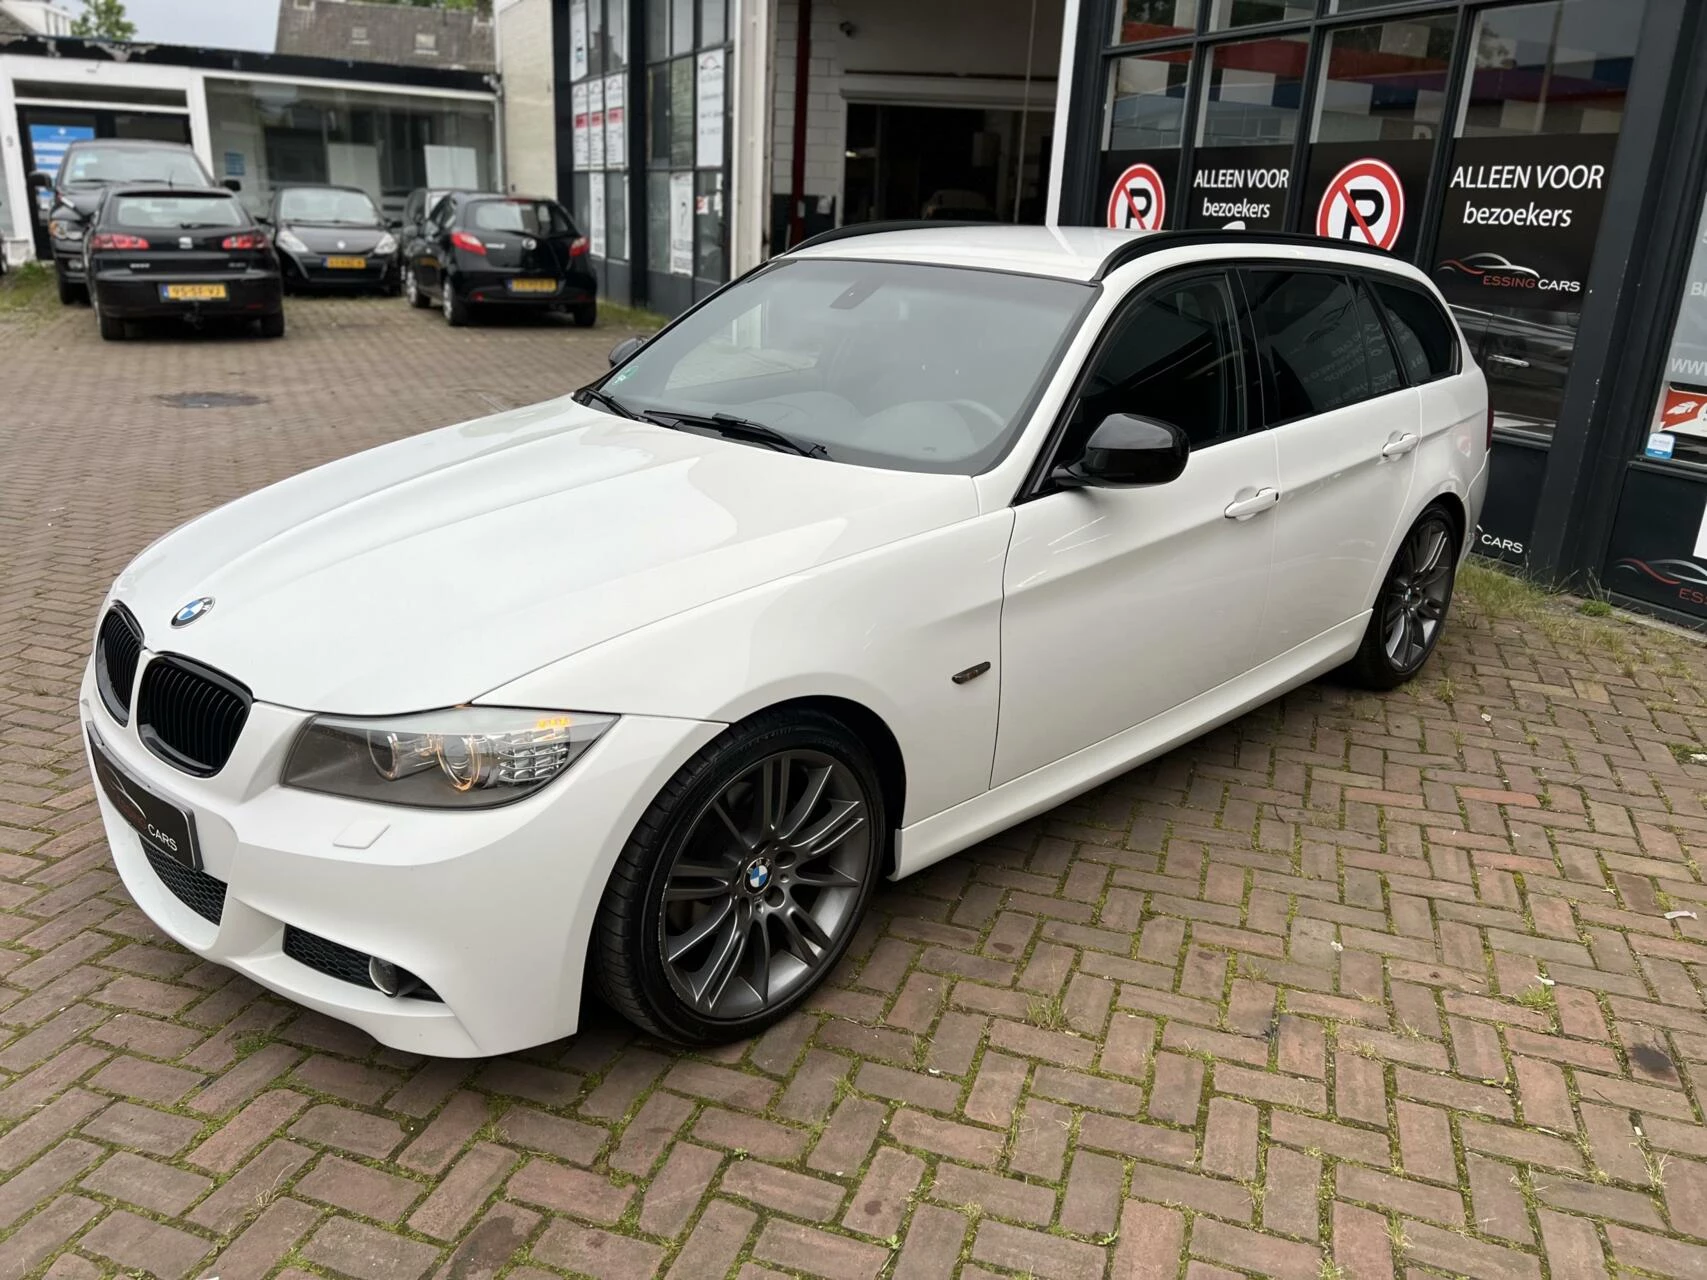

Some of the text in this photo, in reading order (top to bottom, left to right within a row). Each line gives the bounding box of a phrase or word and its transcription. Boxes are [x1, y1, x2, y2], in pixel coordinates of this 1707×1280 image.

[1193, 168, 1290, 189] ALLEEN VOOR
[1449, 164, 1605, 189] ALLEEN VOOR
[1202, 196, 1271, 219] bezoekers
[1462, 200, 1573, 228] bezoekers
[1482, 275, 1581, 293] ESSING CARS
[1481, 533, 1524, 554] CARS
[147, 823, 178, 852] CARS
